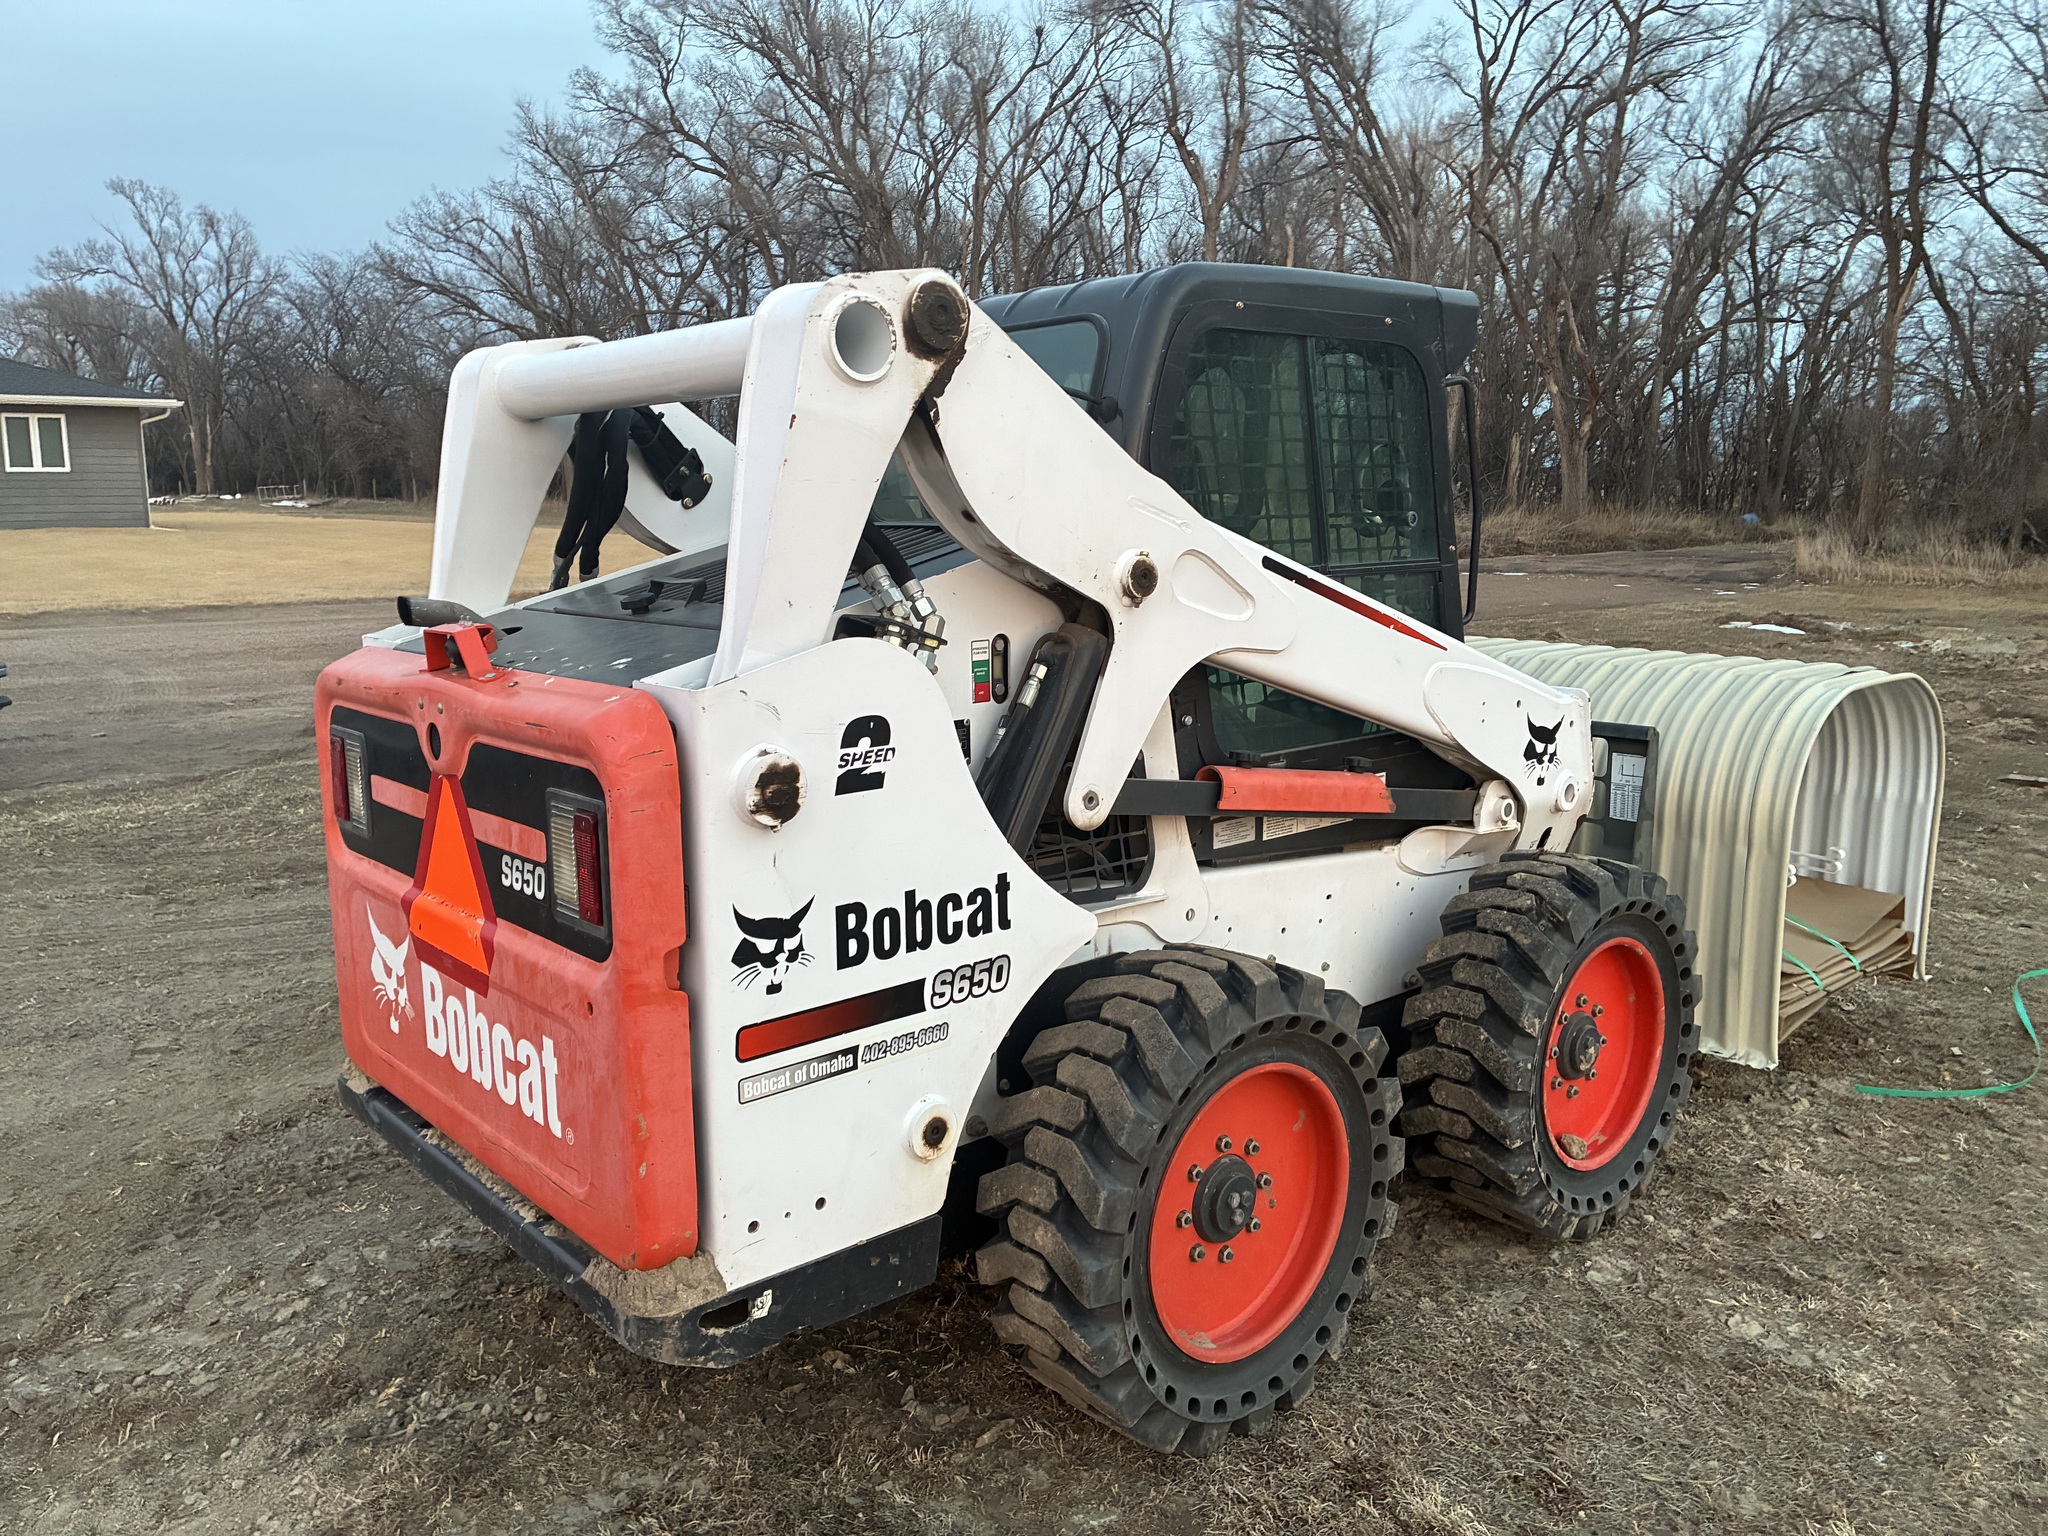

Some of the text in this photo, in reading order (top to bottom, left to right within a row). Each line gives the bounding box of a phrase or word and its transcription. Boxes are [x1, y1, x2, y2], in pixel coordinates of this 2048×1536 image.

[834, 714, 891, 796] 2
[837, 747, 896, 769] SPEED
[501, 854, 546, 900] S650
[835, 872, 1011, 971] Bobcat
[931, 954, 1011, 1009] S650
[420, 961, 562, 1138] Bobcat
[743, 1022, 949, 1099] Bobcat of Omaha 402-895-6660
